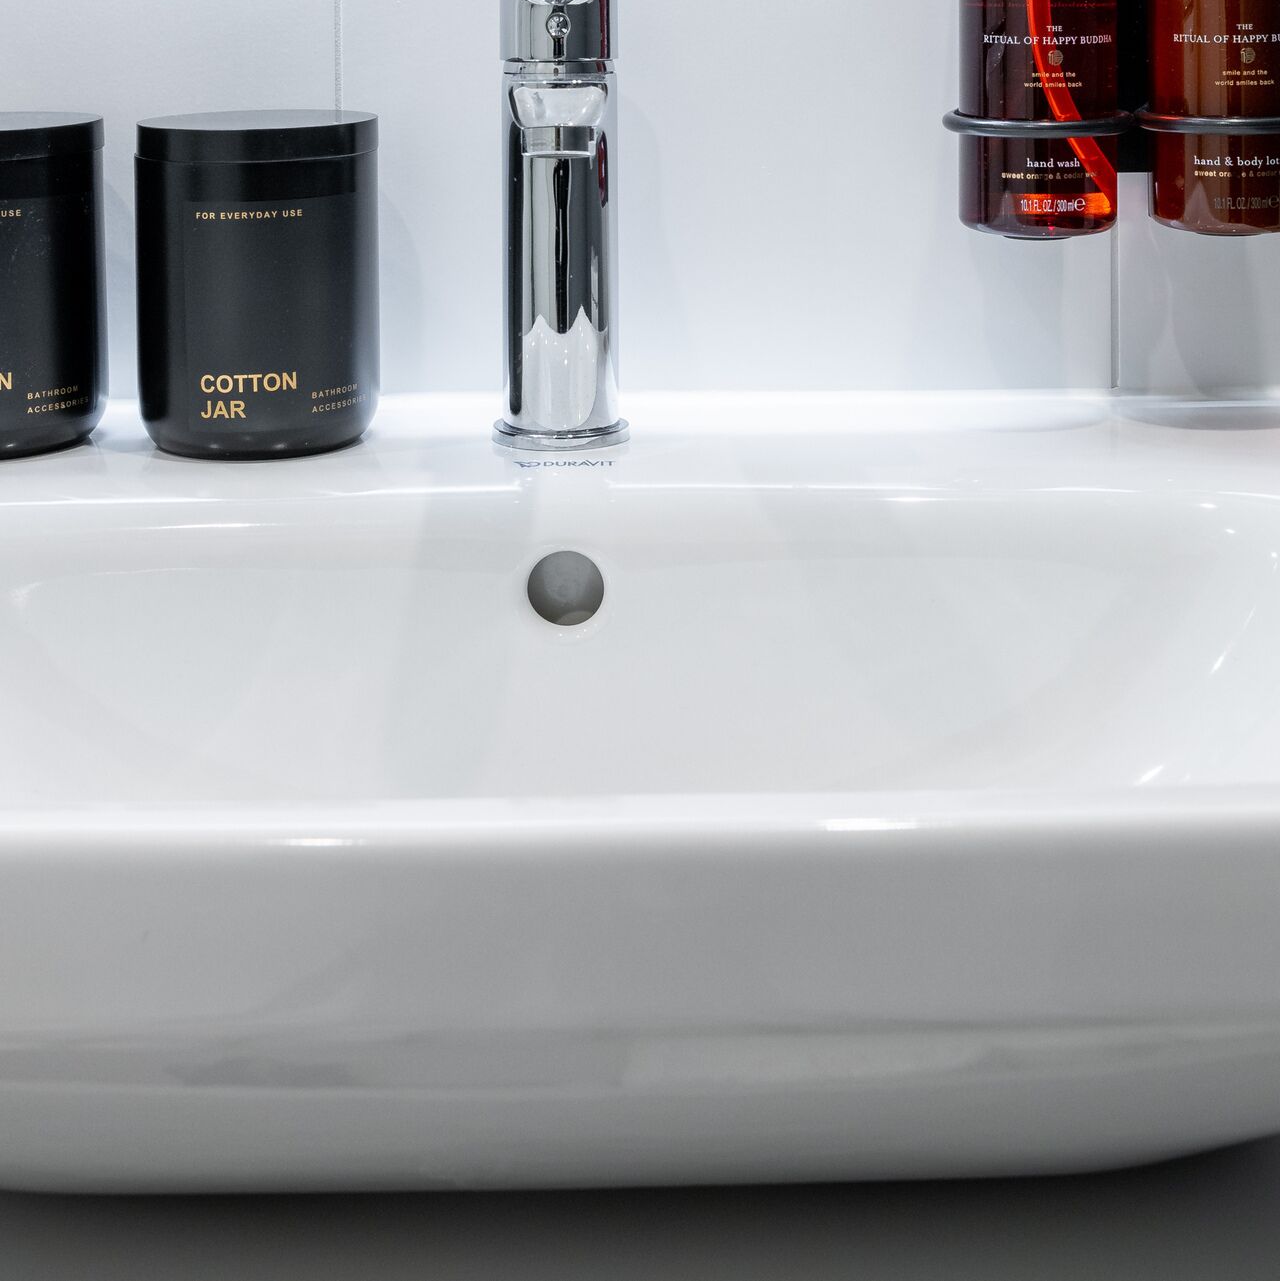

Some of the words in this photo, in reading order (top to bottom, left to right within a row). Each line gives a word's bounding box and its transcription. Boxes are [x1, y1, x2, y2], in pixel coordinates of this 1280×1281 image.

[983, 34, 1021, 45] RITUAL
[1023, 36, 1040, 45] OF
[1042, 36, 1078, 45] HAPPY
[1080, 34, 1112, 44] BUDDHA
[1173, 33, 1211, 43] RITUAL
[1213, 34, 1230, 43] OF
[1232, 34, 1269, 43] HAPPY
[1026, 157, 1054, 168] hand
[1056, 157, 1081, 168] wash
[1193, 155, 1221, 166] hand
[1224, 156, 1233, 166] &
[1236, 156, 1263, 169] body
[1020, 199, 1032, 212] 10.1
[0, 209, 22, 217] USE
[195, 211, 216, 220] FOR
[220, 210, 278, 220] EVERYDAY
[282, 208, 303, 217] USE
[200, 371, 297, 394] COTTON
[27, 384, 79, 400] BATHROOM
[311, 383, 359, 399] BATHROOM
[27, 395, 90, 414] ACCESSORIES
[200, 400, 247, 419] JAR
[311, 393, 368, 414] ACCESSORIES
